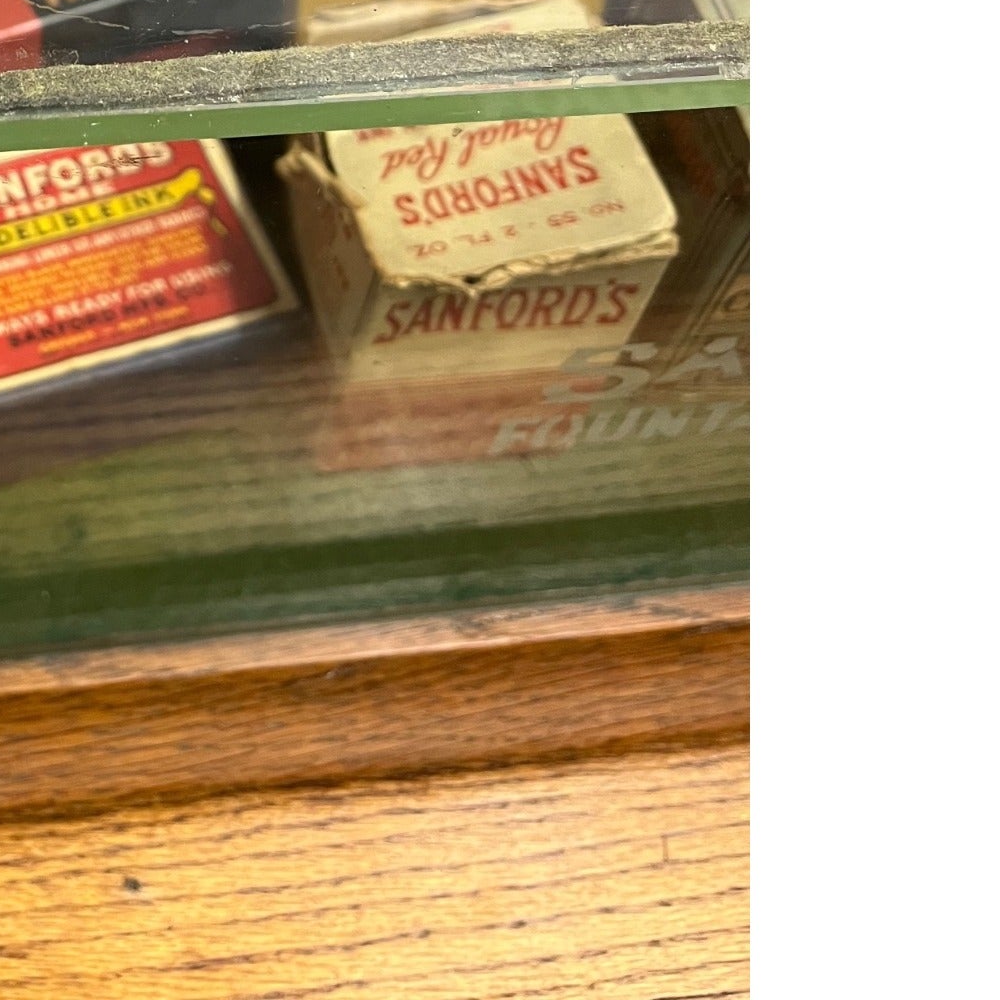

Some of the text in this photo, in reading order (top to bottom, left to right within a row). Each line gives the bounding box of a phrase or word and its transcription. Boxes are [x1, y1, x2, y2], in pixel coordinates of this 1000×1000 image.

[380, 136, 449, 182] Red
[4, 179, 116, 221] HOME
[124, 186, 176, 211] INK
[394, 144, 600, 226] SANFORD'S
[53, 290, 123, 321] READY
[125, 277, 168, 300] FOR
[374, 278, 641, 344] SANFORD'S
[8, 309, 117, 346] SANFORD
